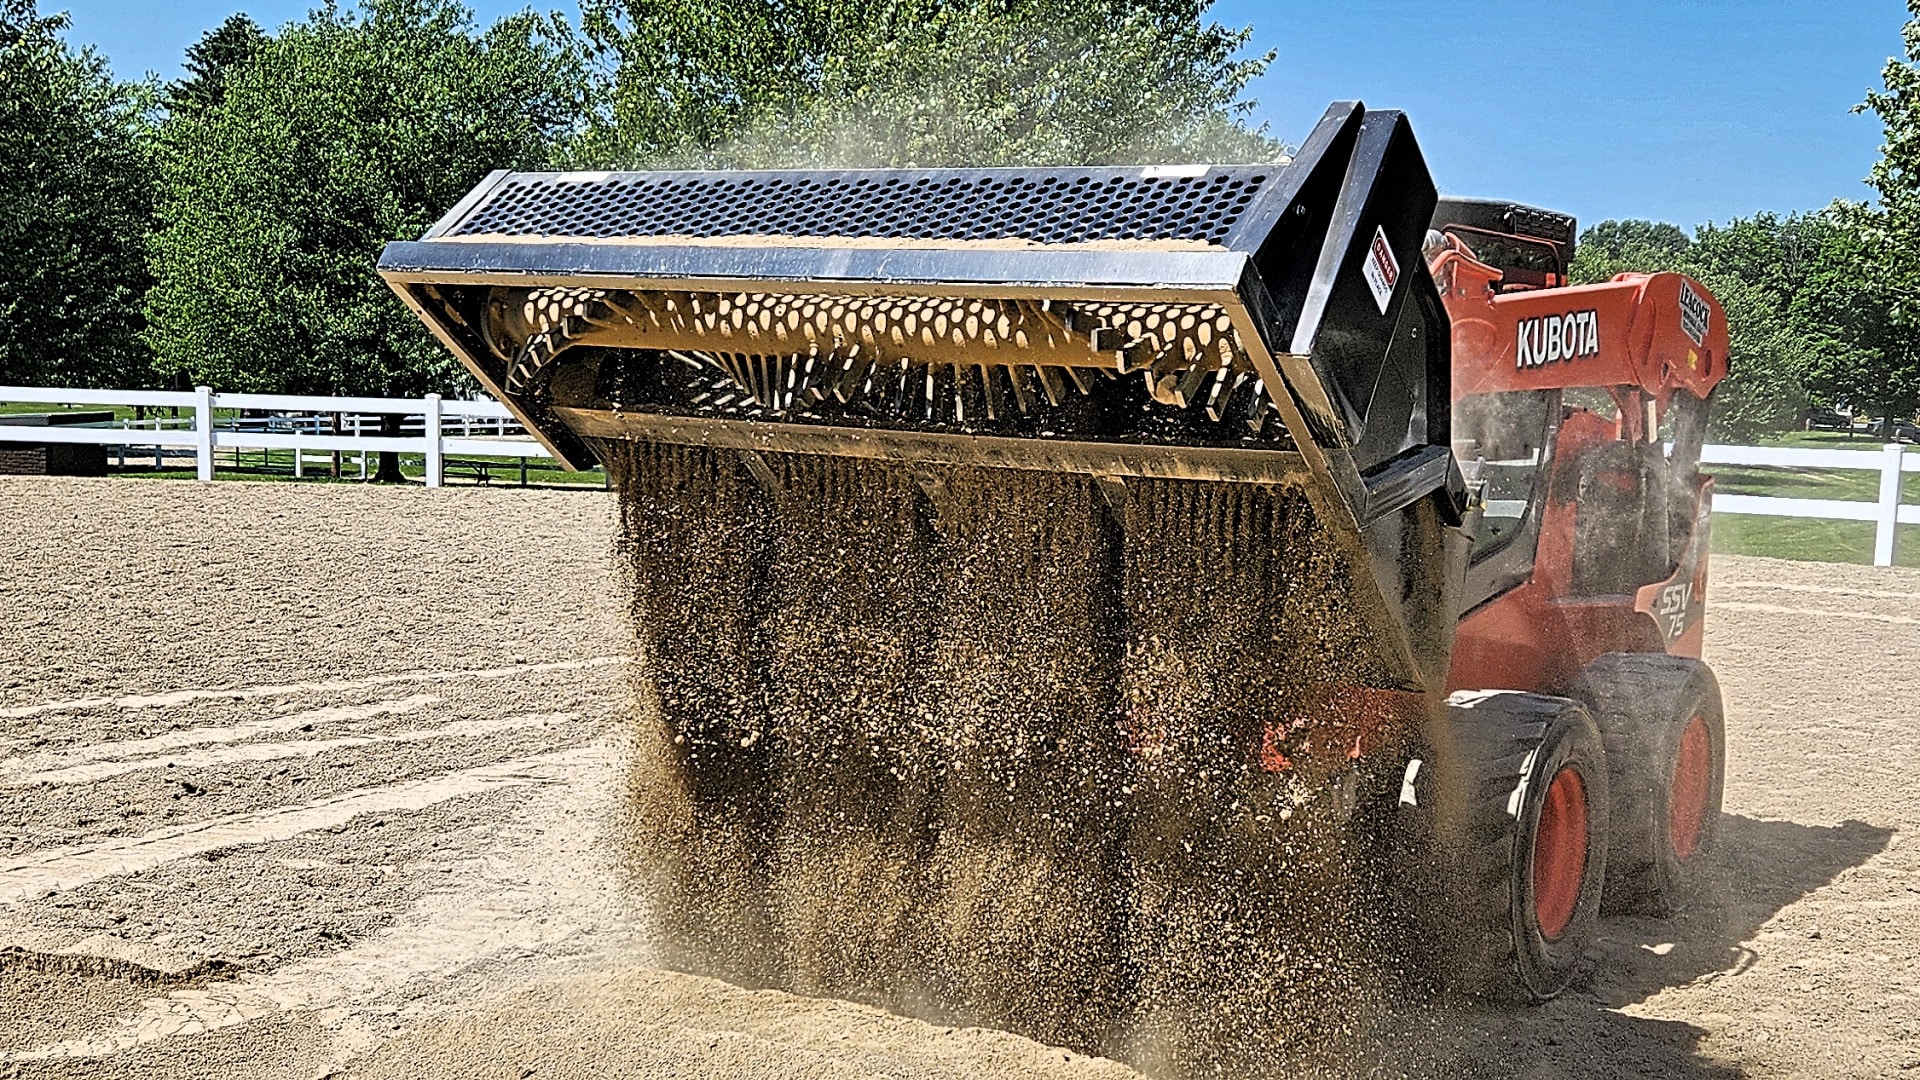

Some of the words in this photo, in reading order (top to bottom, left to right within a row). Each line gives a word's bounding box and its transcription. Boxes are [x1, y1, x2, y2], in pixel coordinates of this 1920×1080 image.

[1376, 242, 1393, 281] DANGER
[1516, 309, 1599, 370] KUBOTA
[1660, 582, 1693, 615] SSV
[1667, 612, 1685, 638] 75
